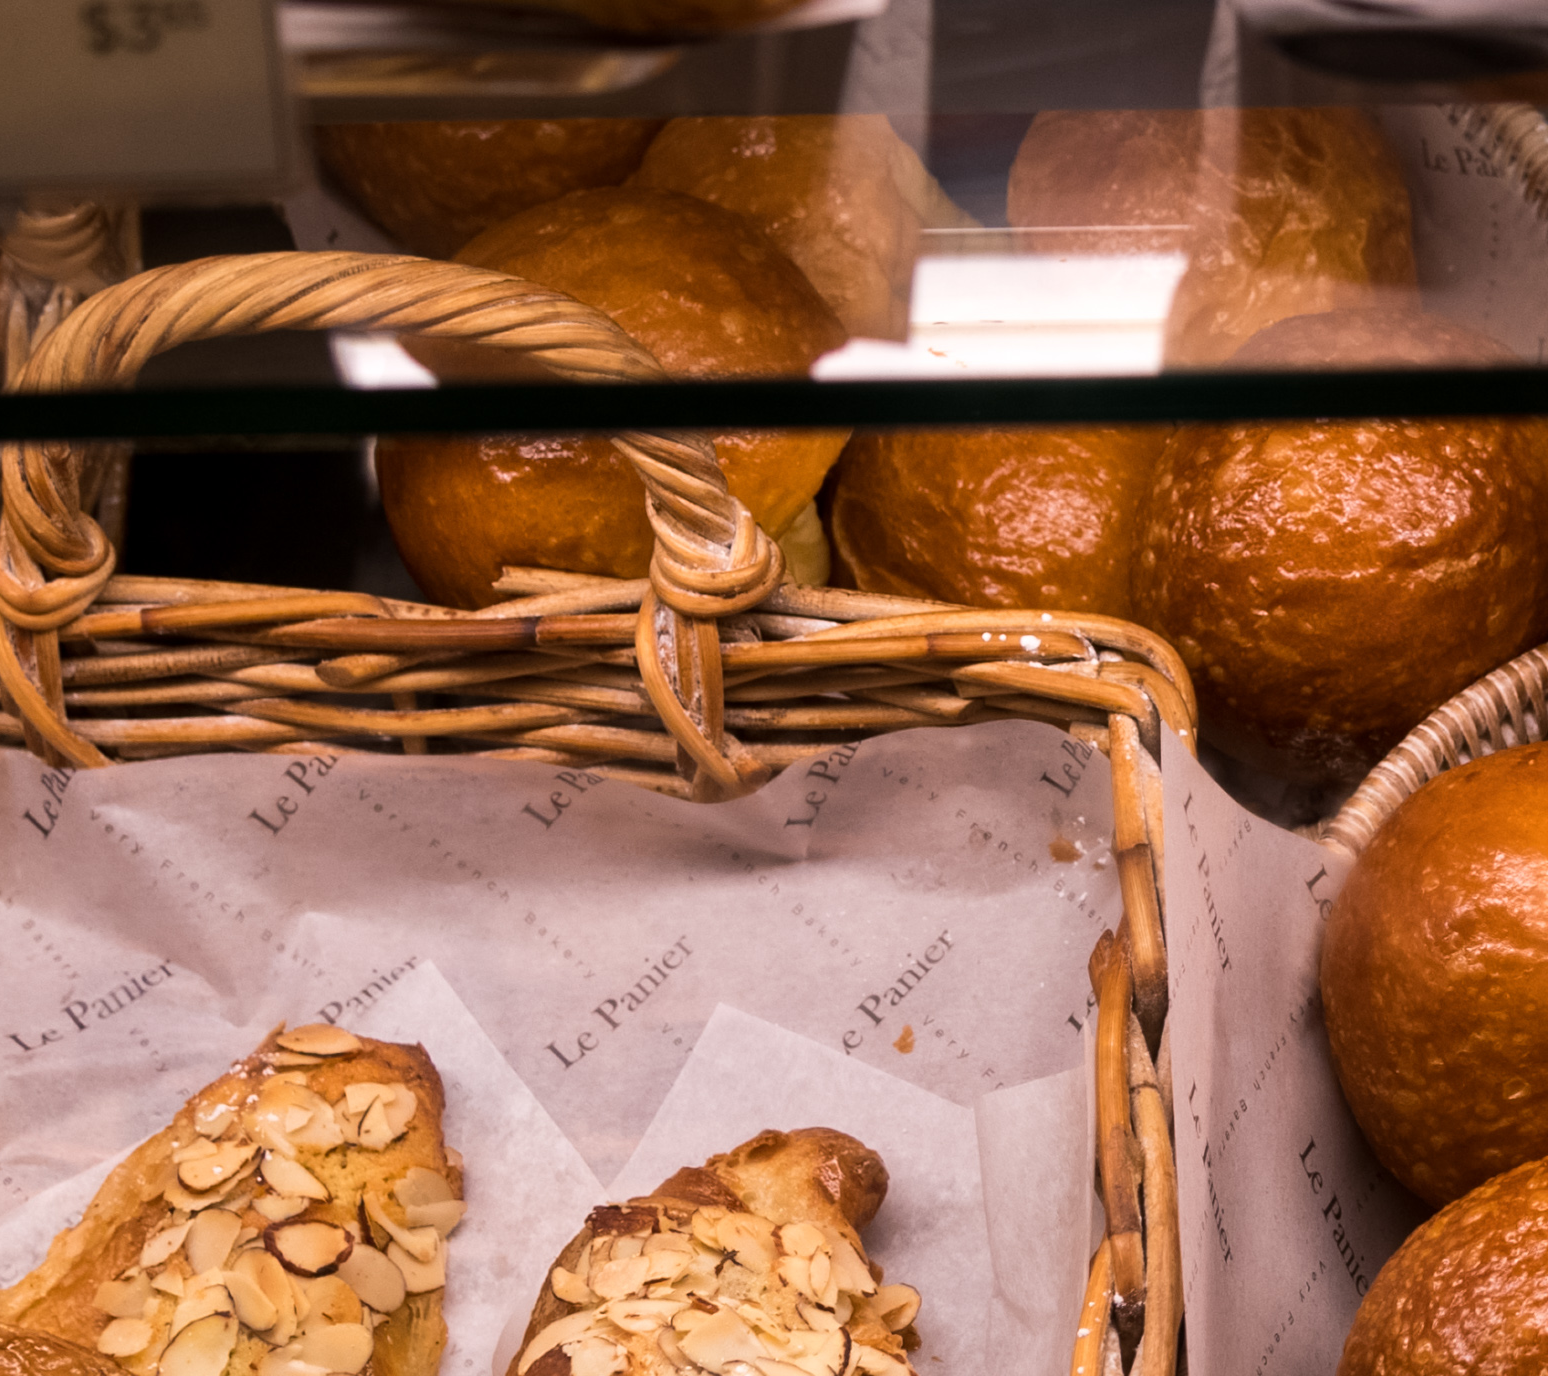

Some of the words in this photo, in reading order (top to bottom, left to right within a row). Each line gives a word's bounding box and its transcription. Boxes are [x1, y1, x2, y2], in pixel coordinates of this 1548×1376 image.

[246, 788, 301, 838] Le
[520, 787, 575, 831] Le
[781, 790, 828, 830] Le
[1039, 762, 1081, 799] Le
[22, 799, 59, 840] Le
[880, 764, 940, 803] Very
[954, 807, 1041, 875] French
[88, 808, 146, 856] Very
[159, 857, 247, 925] French
[358, 787, 413, 833] Very
[427, 836, 512, 903] French
[522, 910, 599, 982] Bakery
[1304, 862, 1333, 922] Le
[789, 902, 863, 968] Bakery
[1196, 853, 1233, 974] Panier
[21, 918, 83, 982] Bakery
[854, 927, 957, 1027] Panier
[3, 1019, 63, 1055] Le
[59, 956, 180, 1034] Panier
[314, 951, 423, 1024] Panier
[545, 1030, 601, 1071] Le
[590, 932, 696, 1031] Panier
[920, 1013, 970, 1061] Very
[1298, 1134, 1324, 1195] Le
[1321, 1195, 1370, 1298] Panie
[1297, 1260, 1328, 1303] Very
